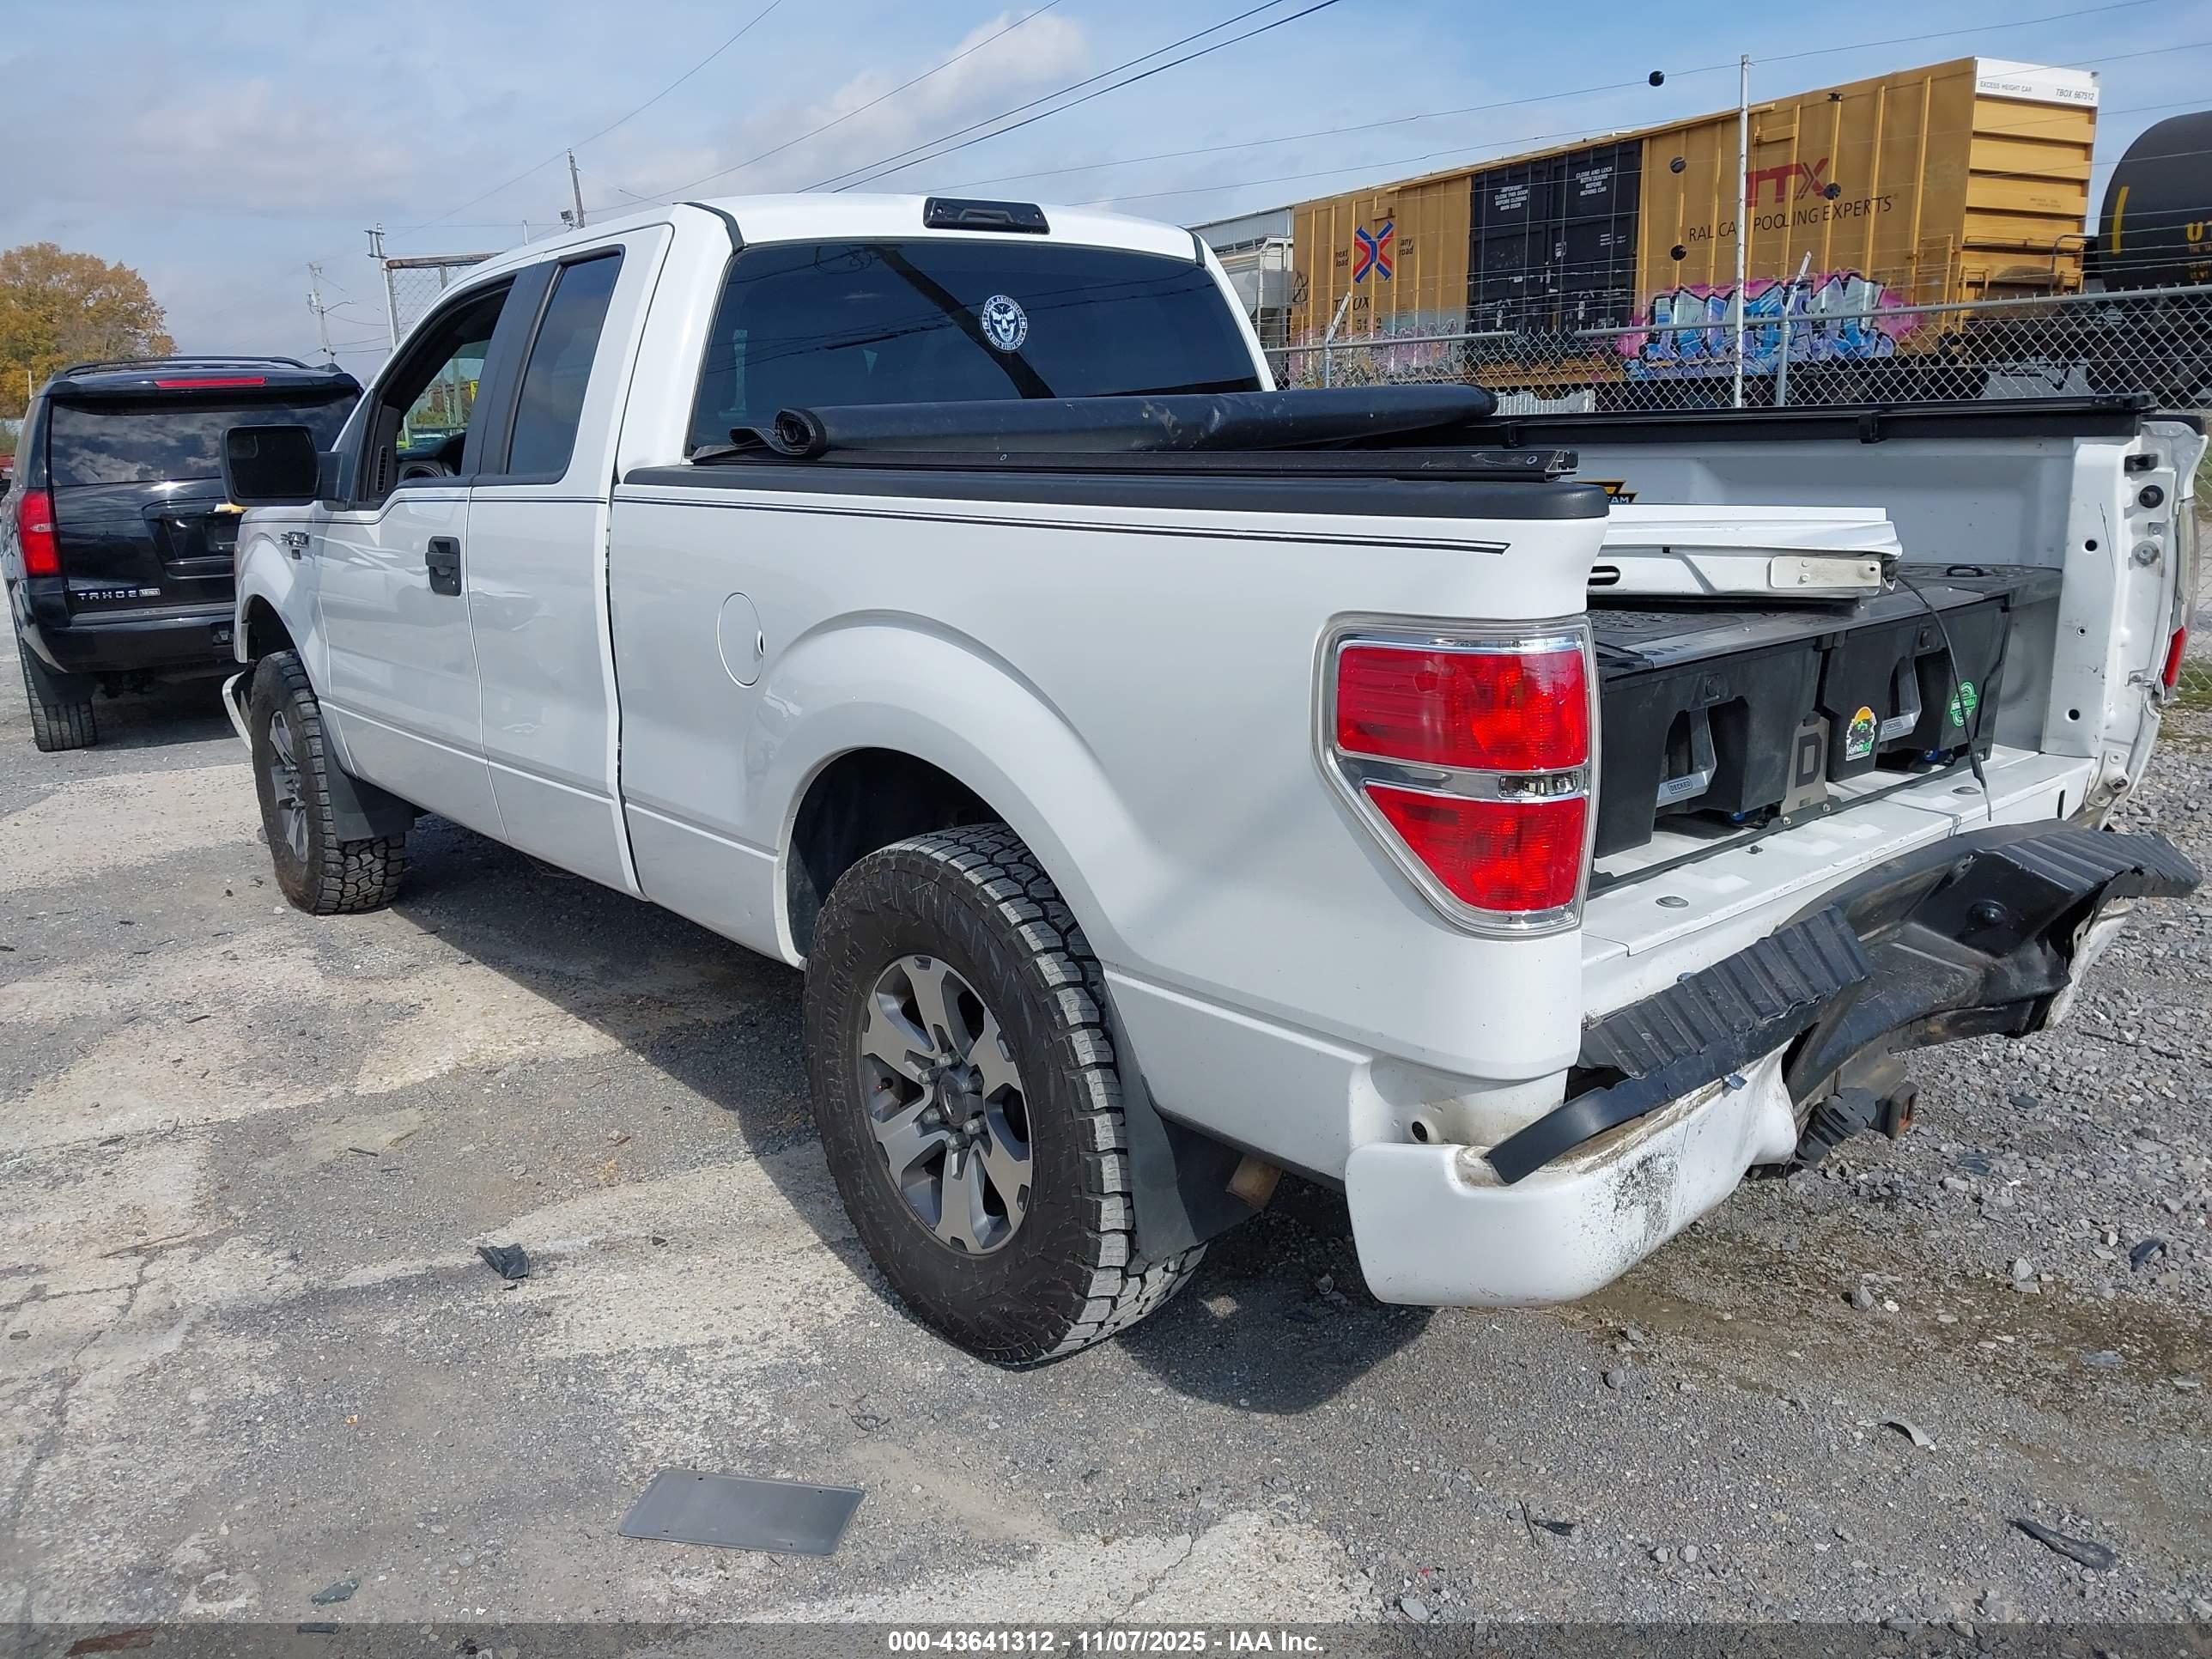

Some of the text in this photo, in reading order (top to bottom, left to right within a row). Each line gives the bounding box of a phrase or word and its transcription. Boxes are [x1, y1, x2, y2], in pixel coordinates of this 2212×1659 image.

[1979, 81, 2000, 89] EXCESS
[2056, 88, 2073, 97] TBOX
[1718, 221, 1737, 237] CA
[1753, 207, 1818, 232] POOLING
[1823, 194, 1892, 221] EXPERTS
[1400, 238, 1413, 248] any
[1334, 249, 1348, 258] next
[1398, 246, 1414, 256] road
[1335, 258, 1349, 268] load
[1334, 296, 1370, 312] TOX
[77, 590, 137, 601] TAHOE
[1669, 780, 1692, 792] DECKED
